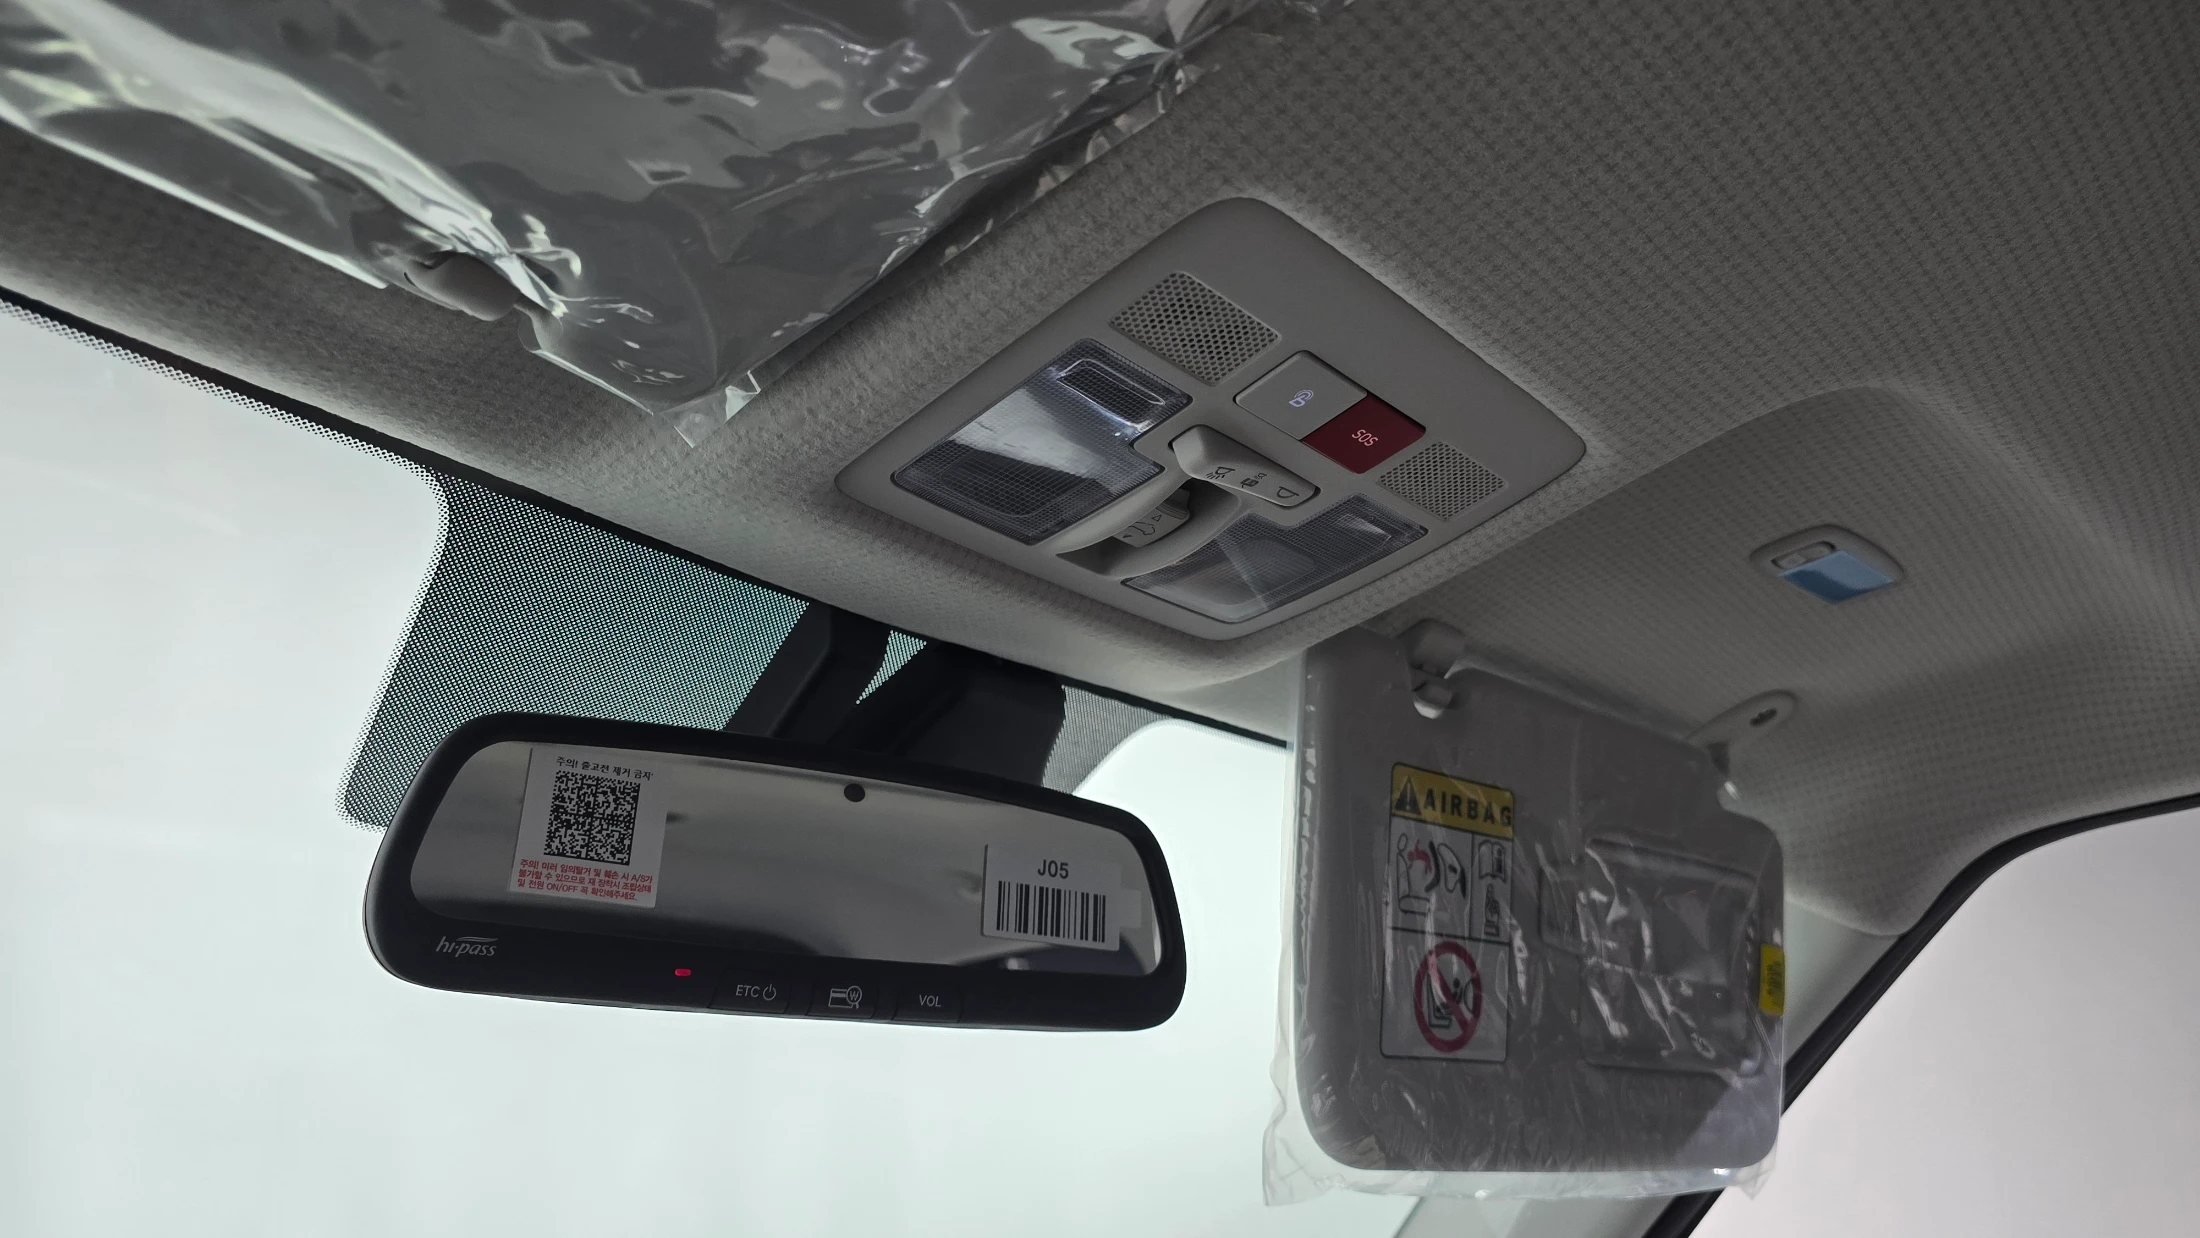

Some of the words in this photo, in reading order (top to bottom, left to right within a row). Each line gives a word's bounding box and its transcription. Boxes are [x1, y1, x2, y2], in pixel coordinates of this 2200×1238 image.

[1351, 429, 1379, 447] SOS
[556, 756, 578, 769] 주의!
[581, 761, 610, 774] 출고전
[612, 766, 631, 777] 제거
[1423, 788, 1512, 827] AIRBAG
[518, 868, 543, 880] 불가할
[544, 871, 553, 881] 수
[555, 873, 586, 885] 있으므로
[520, 859, 539, 870] 주의!
[541, 860, 558, 872] 미러
[593, 868, 602, 878] 및
[621, 872, 630, 881] 시
[631, 874, 653, 884] A/S가
[1037, 858, 1069, 879] J05
[517, 878, 526, 888] 및
[528, 879, 544, 890] 전원
[546, 882, 579, 893] ON/OFF
[580, 885, 589, 895] 꼭
[735, 984, 761, 998] ETC
[918, 994, 942, 1008] VOL
